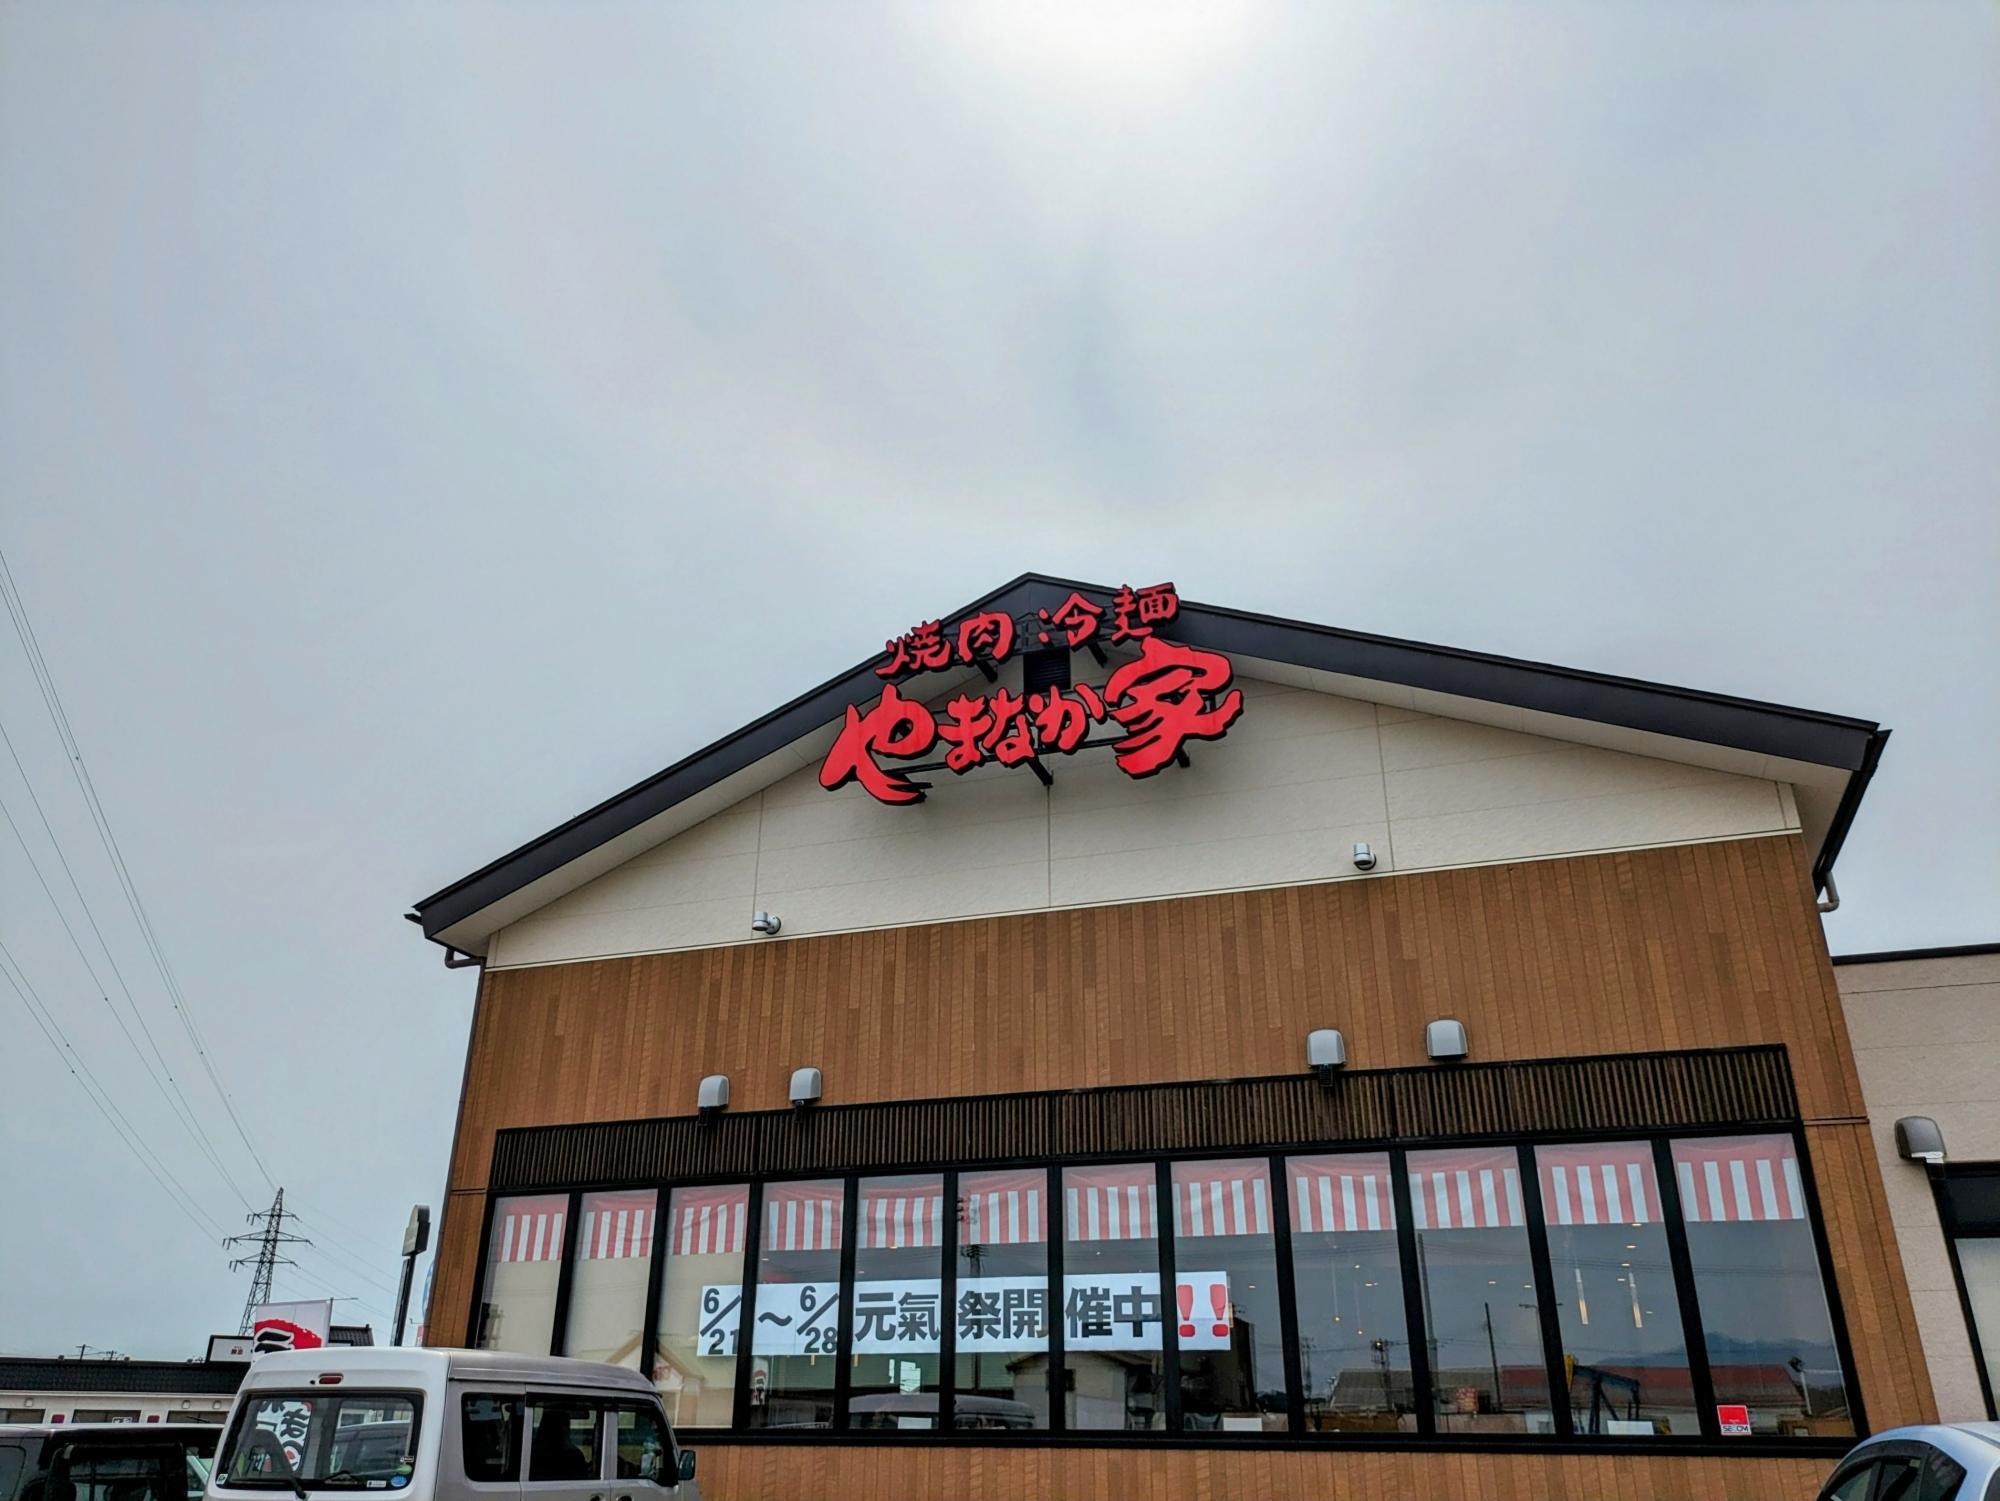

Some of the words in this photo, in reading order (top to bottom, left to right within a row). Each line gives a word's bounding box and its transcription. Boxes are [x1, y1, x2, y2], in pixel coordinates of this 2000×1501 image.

[876, 611, 1015, 677] 焼肉
[1038, 582, 1179, 646] 冷麺
[819, 636, 1244, 806] やまなか家
